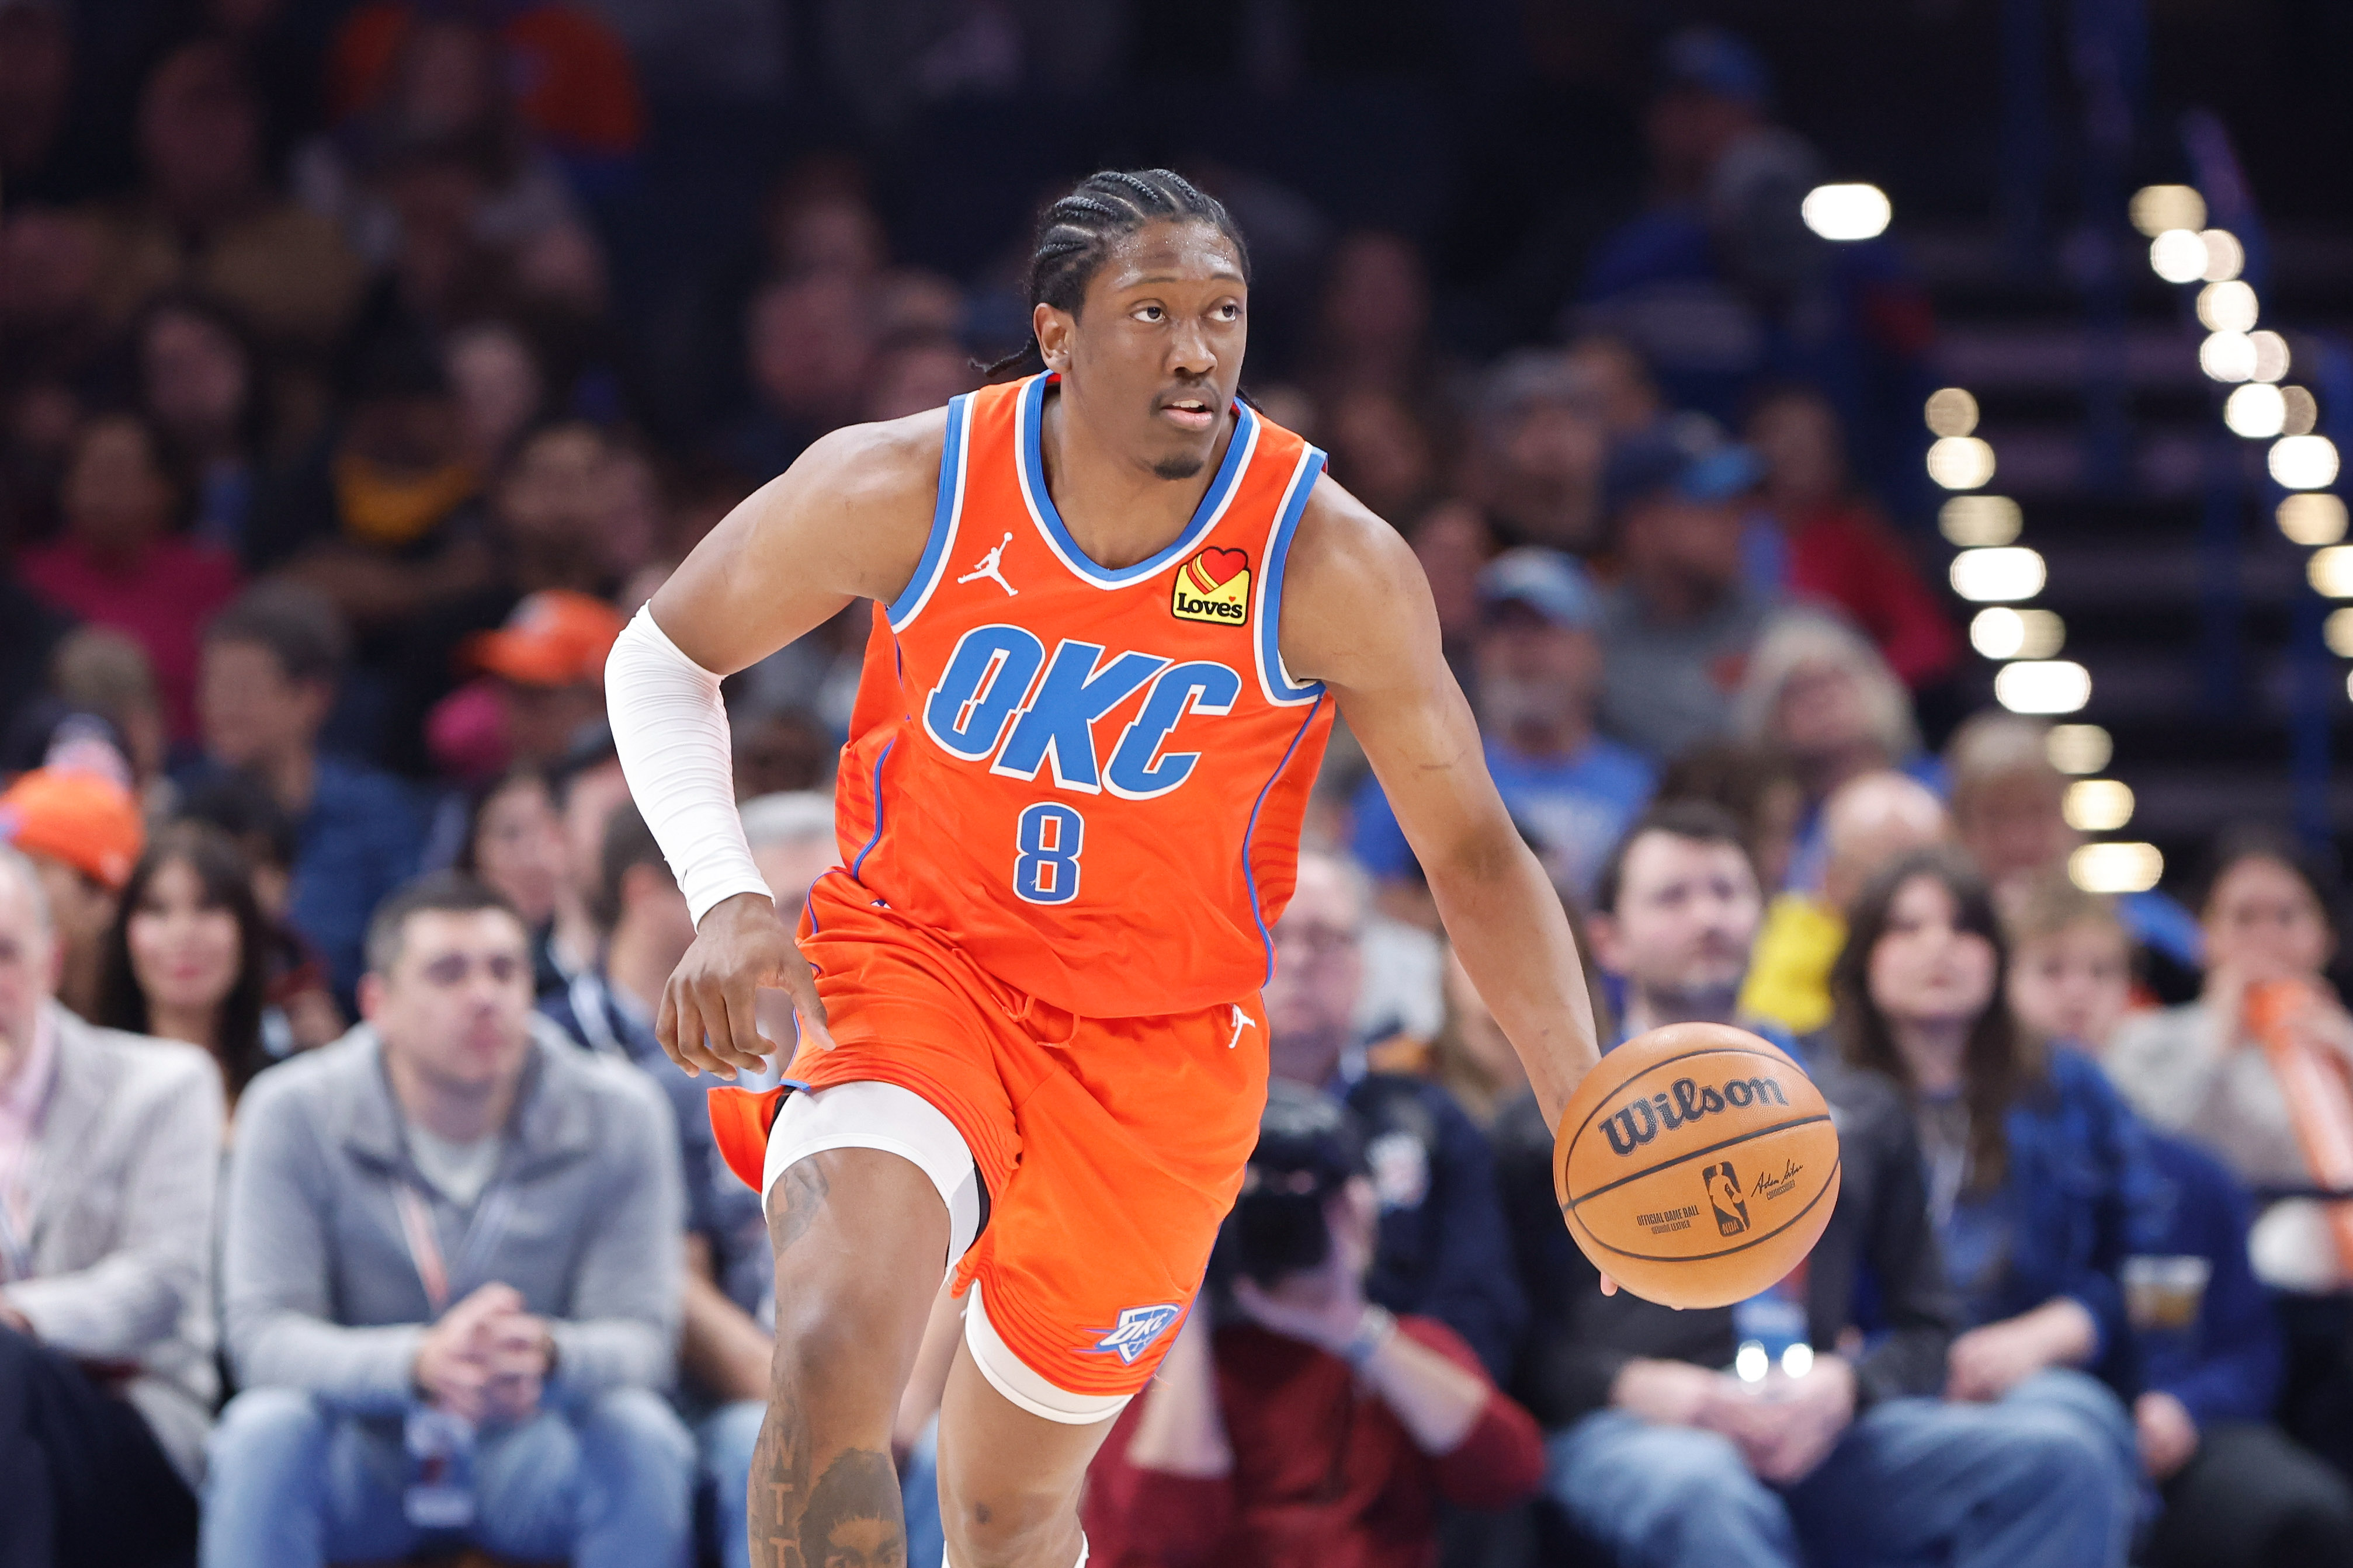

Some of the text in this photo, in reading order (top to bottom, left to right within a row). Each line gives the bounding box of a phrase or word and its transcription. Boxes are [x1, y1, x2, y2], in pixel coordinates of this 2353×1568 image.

[922, 623, 1242, 801] OKC
[1012, 801, 1085, 905] 8
[1598, 1077, 1789, 1156] Wilson
[1636, 1205, 1700, 1226] OFFICIAL GAME BALL
[1722, 1219, 1740, 1235] NBA
[1099, 1312, 1168, 1346] OKC
